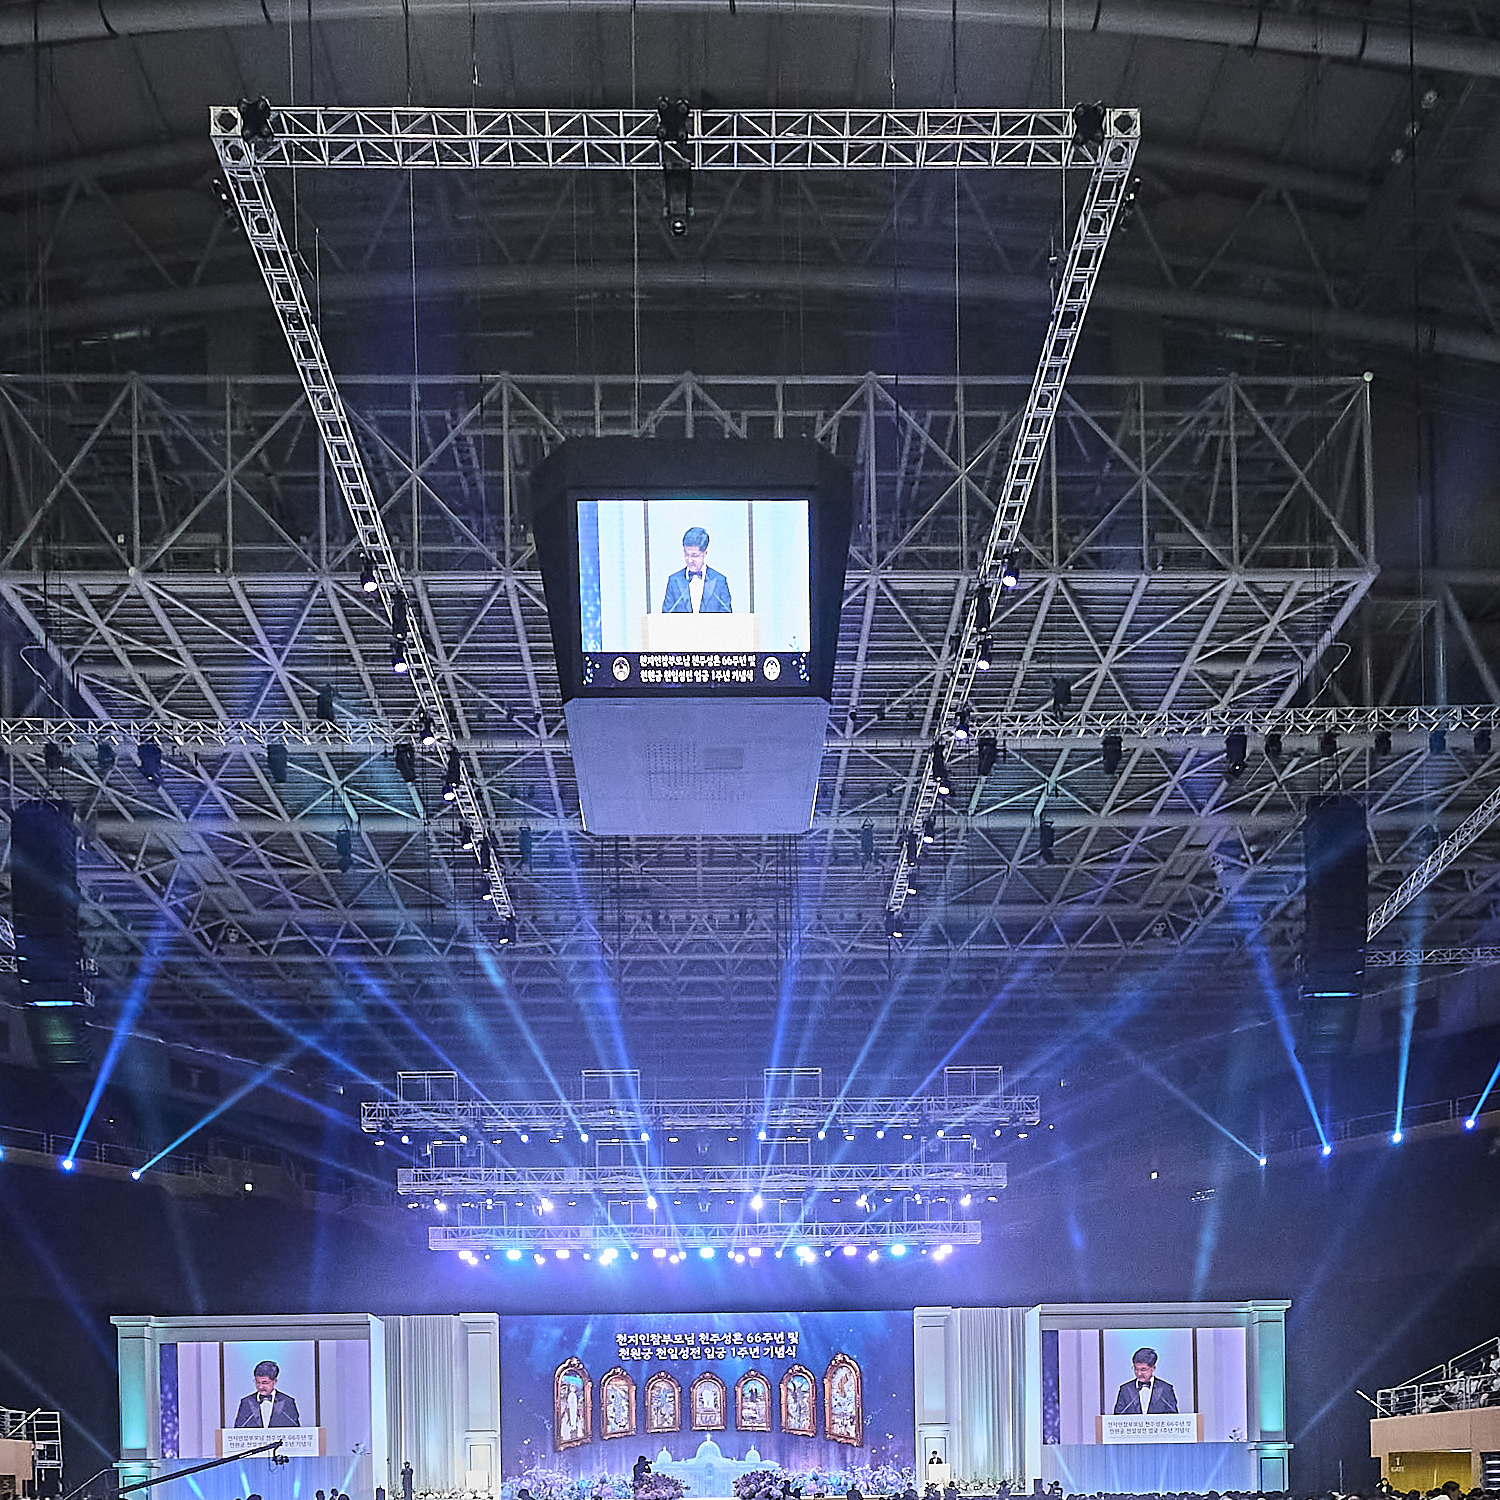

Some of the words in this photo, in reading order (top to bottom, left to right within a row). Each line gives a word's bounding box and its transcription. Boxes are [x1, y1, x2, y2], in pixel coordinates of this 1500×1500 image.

[616, 1332, 695, 1346] 천지인참부모님
[746, 1331, 786, 1345] 66주년
[787, 1331, 800, 1345] 및
[618, 1347, 654, 1361] 천원궁
[655, 1347, 702, 1360] 천일성전
[703, 1346, 727, 1360] 입궁
[730, 1346, 760, 1359] 1주년
[762, 1345, 797, 1359] 기념식
